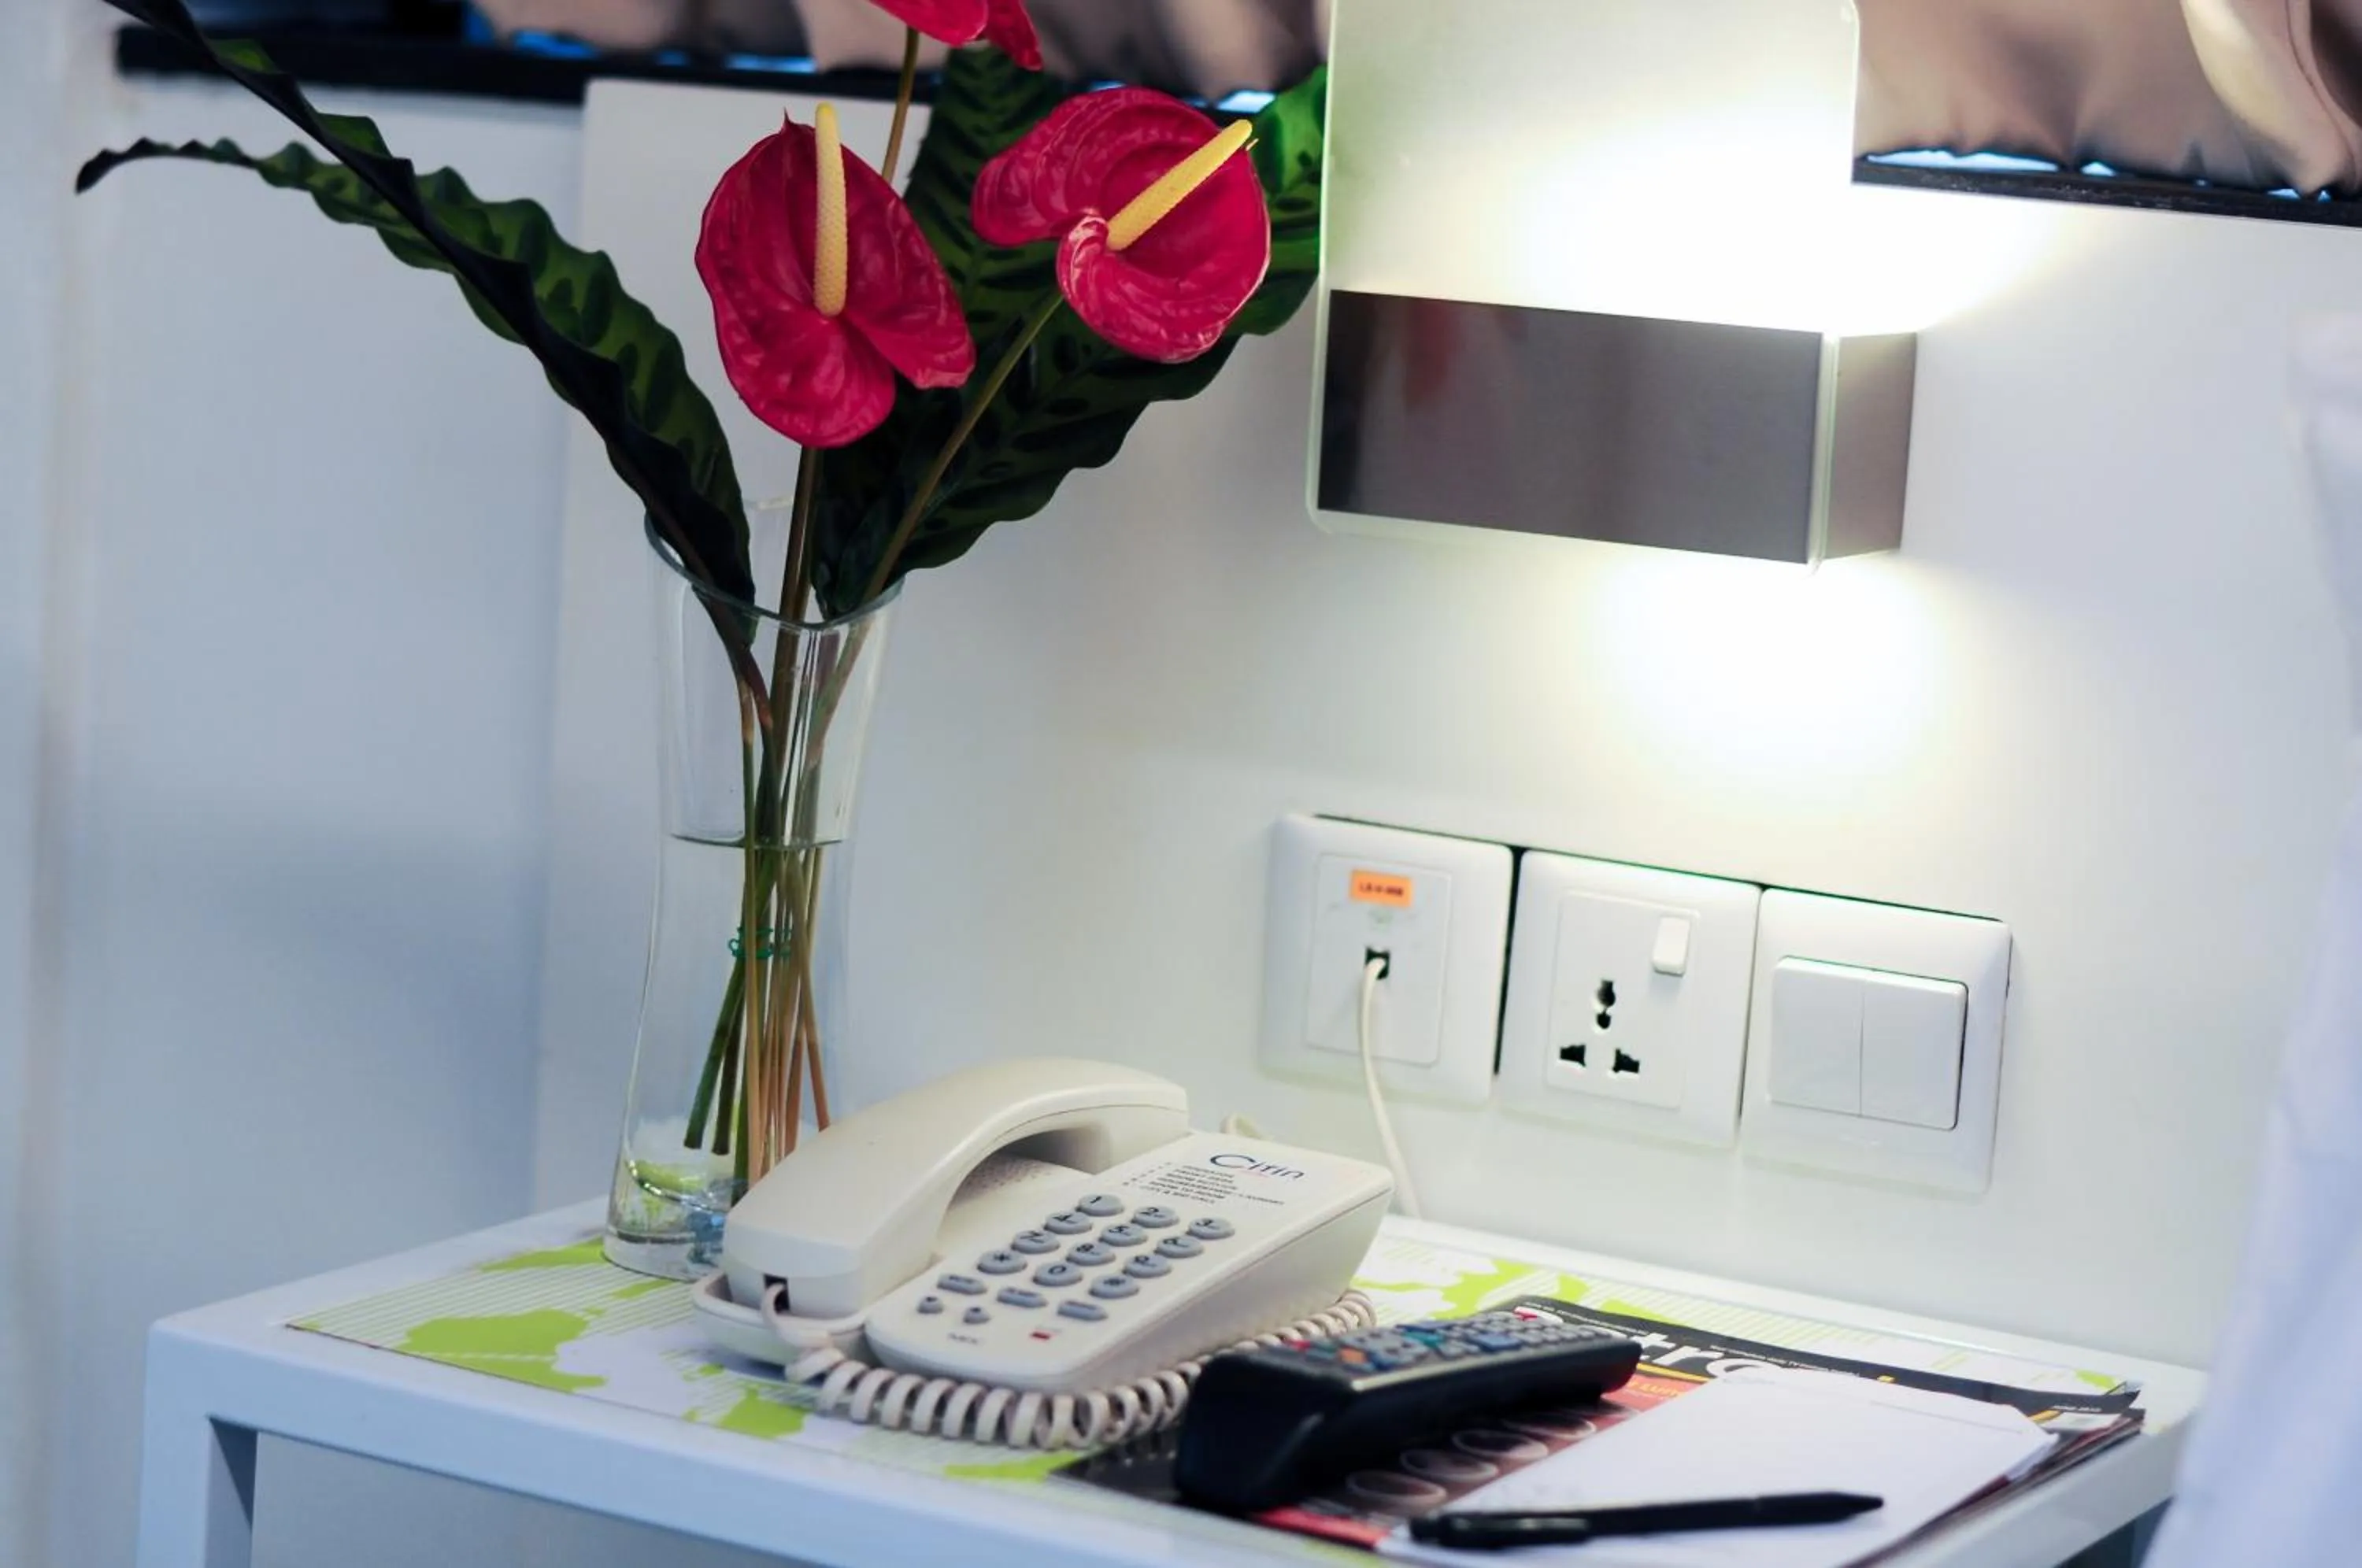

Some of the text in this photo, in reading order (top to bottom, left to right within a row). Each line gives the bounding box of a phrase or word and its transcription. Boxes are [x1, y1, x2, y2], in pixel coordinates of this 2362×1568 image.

[1140, 1207, 1159, 1215] 2
[1194, 1218, 1214, 1226] 3
[1048, 1266, 1067, 1274] 0
